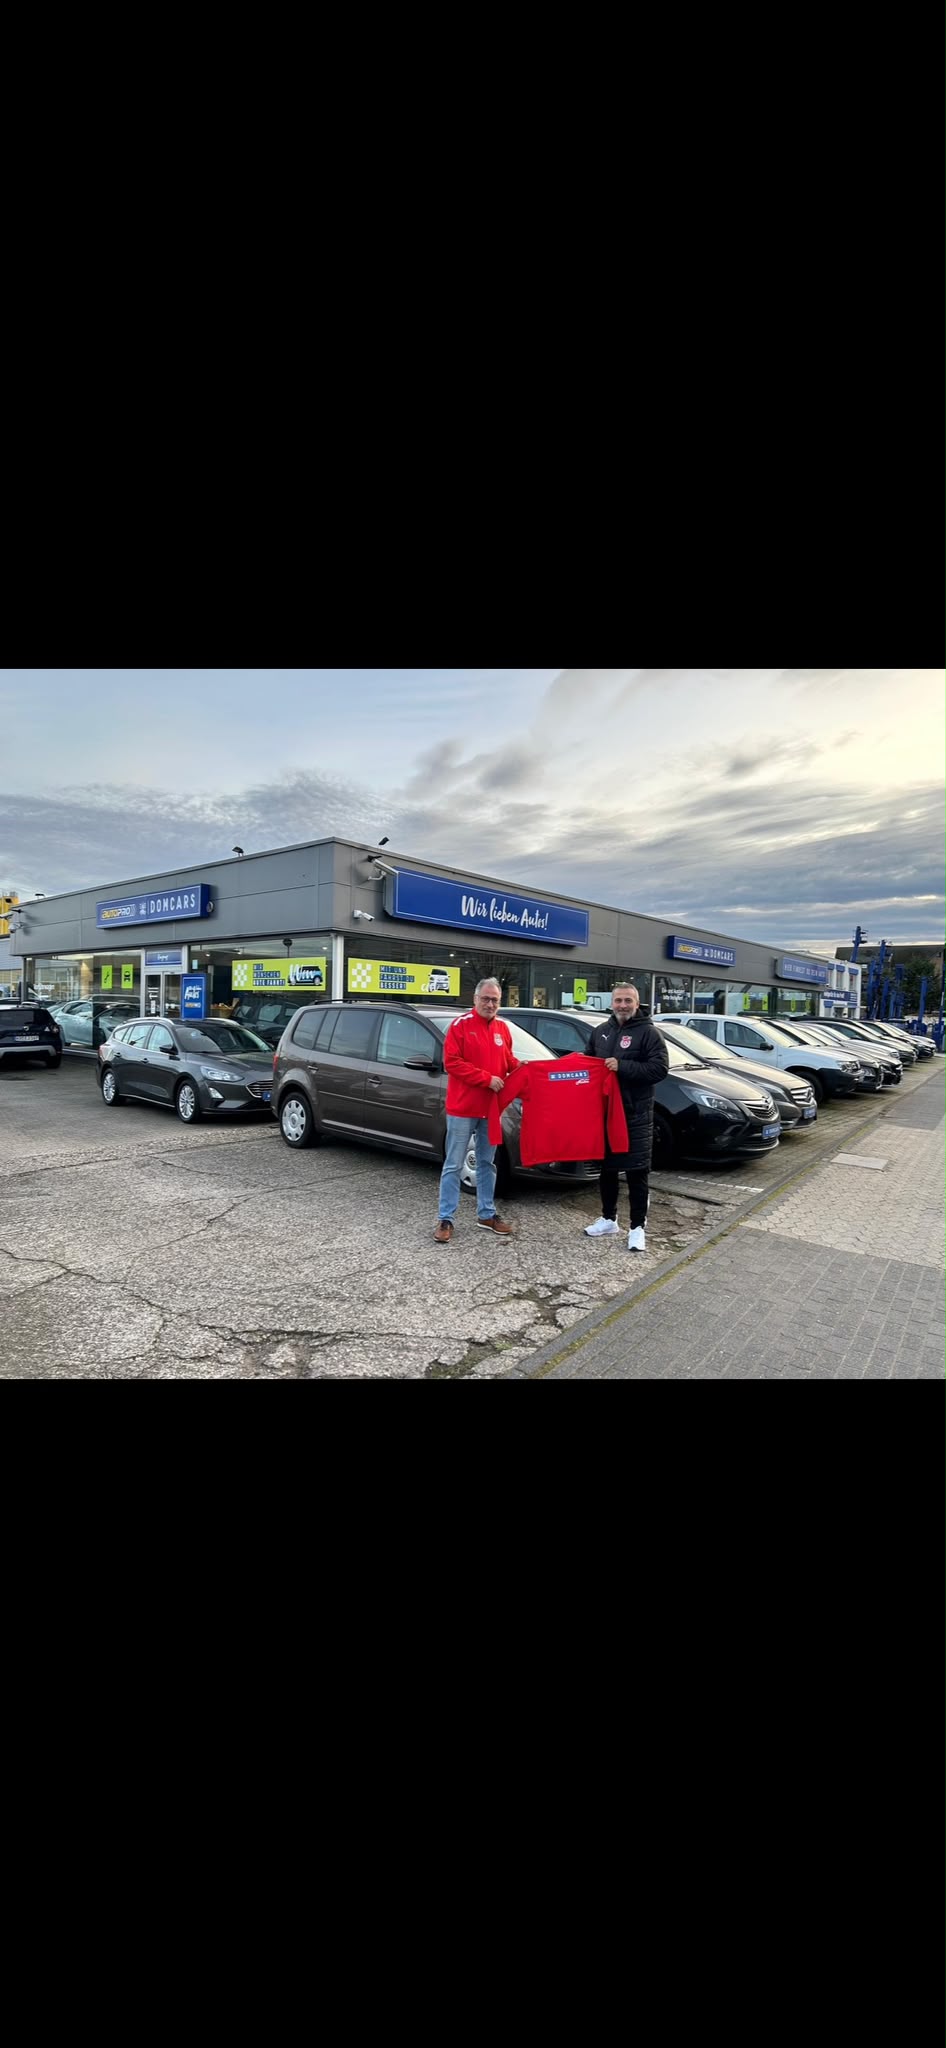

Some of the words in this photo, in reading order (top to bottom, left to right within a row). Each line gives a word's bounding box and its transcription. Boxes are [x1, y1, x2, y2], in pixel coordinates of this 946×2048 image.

[150, 893, 196, 914] DOMCARS
[461, 895, 488, 918] Wir
[489, 897, 520, 923] lieben
[520, 908, 549, 930] Autos!
[710, 948, 734, 961] DOMCARS
[558, 1071, 588, 1079] DOMCARS
